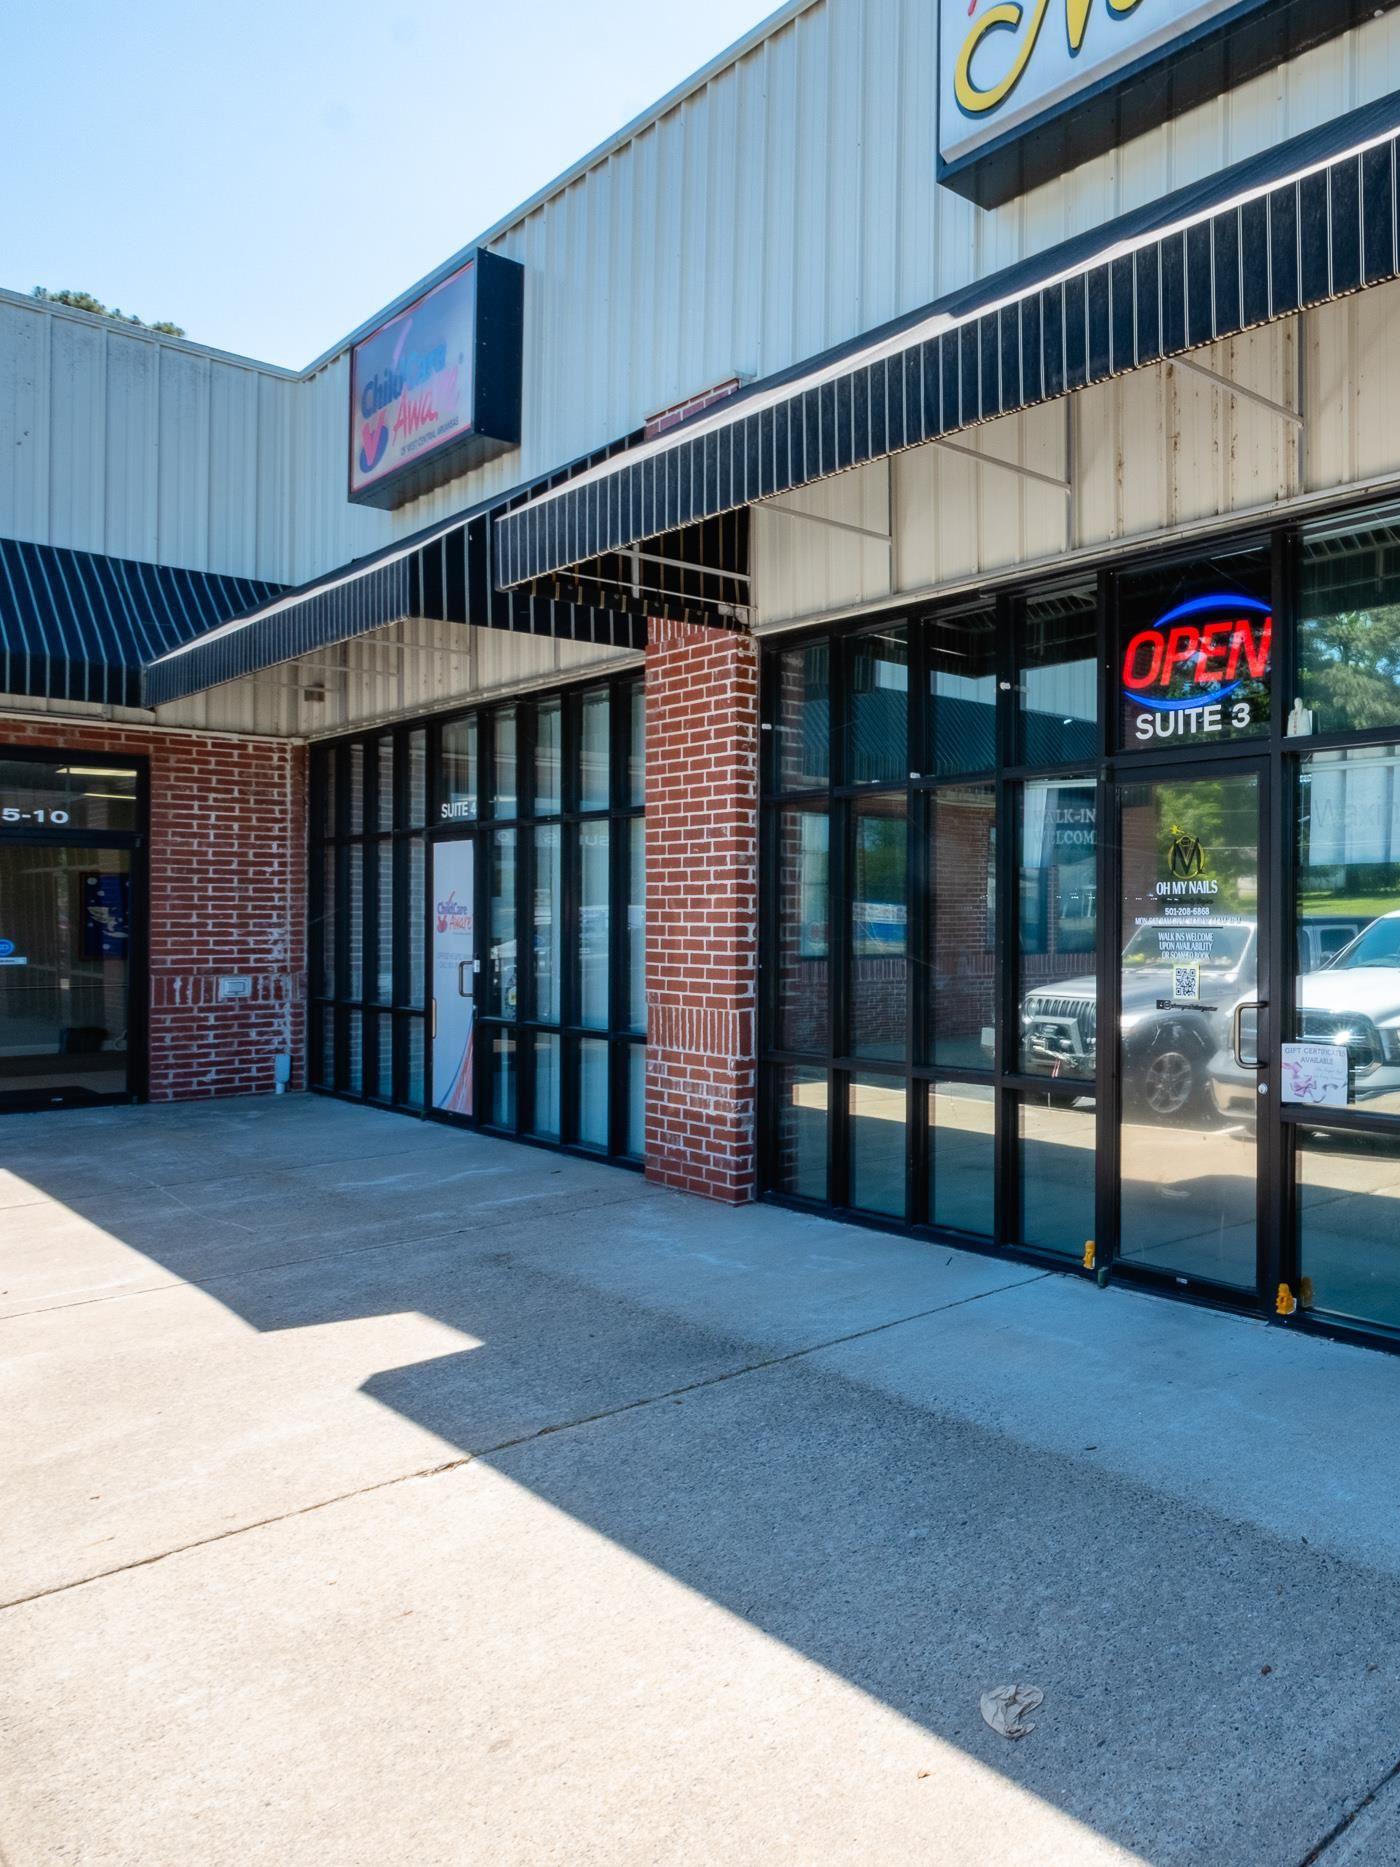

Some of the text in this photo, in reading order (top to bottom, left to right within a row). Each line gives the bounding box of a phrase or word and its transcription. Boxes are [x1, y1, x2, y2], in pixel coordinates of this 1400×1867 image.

[1122, 617, 1272, 689] OPEN
[1135, 702, 1251, 740] SUITE 3
[1, 807, 69, 824] 5-10
[441, 800, 477, 818] SUITE 4
[1032, 830, 1097, 846] WELCOM
[1156, 879, 1218, 895] OH MY NAILS
[1164, 907, 1210, 916] 501-208-6868
[1158, 932, 1214, 942] WALK INS WELCOME
[1159, 941, 1213, 951] UPON AVAILABILITY
[1300, 1057, 1334, 1065] AVAILABLE
